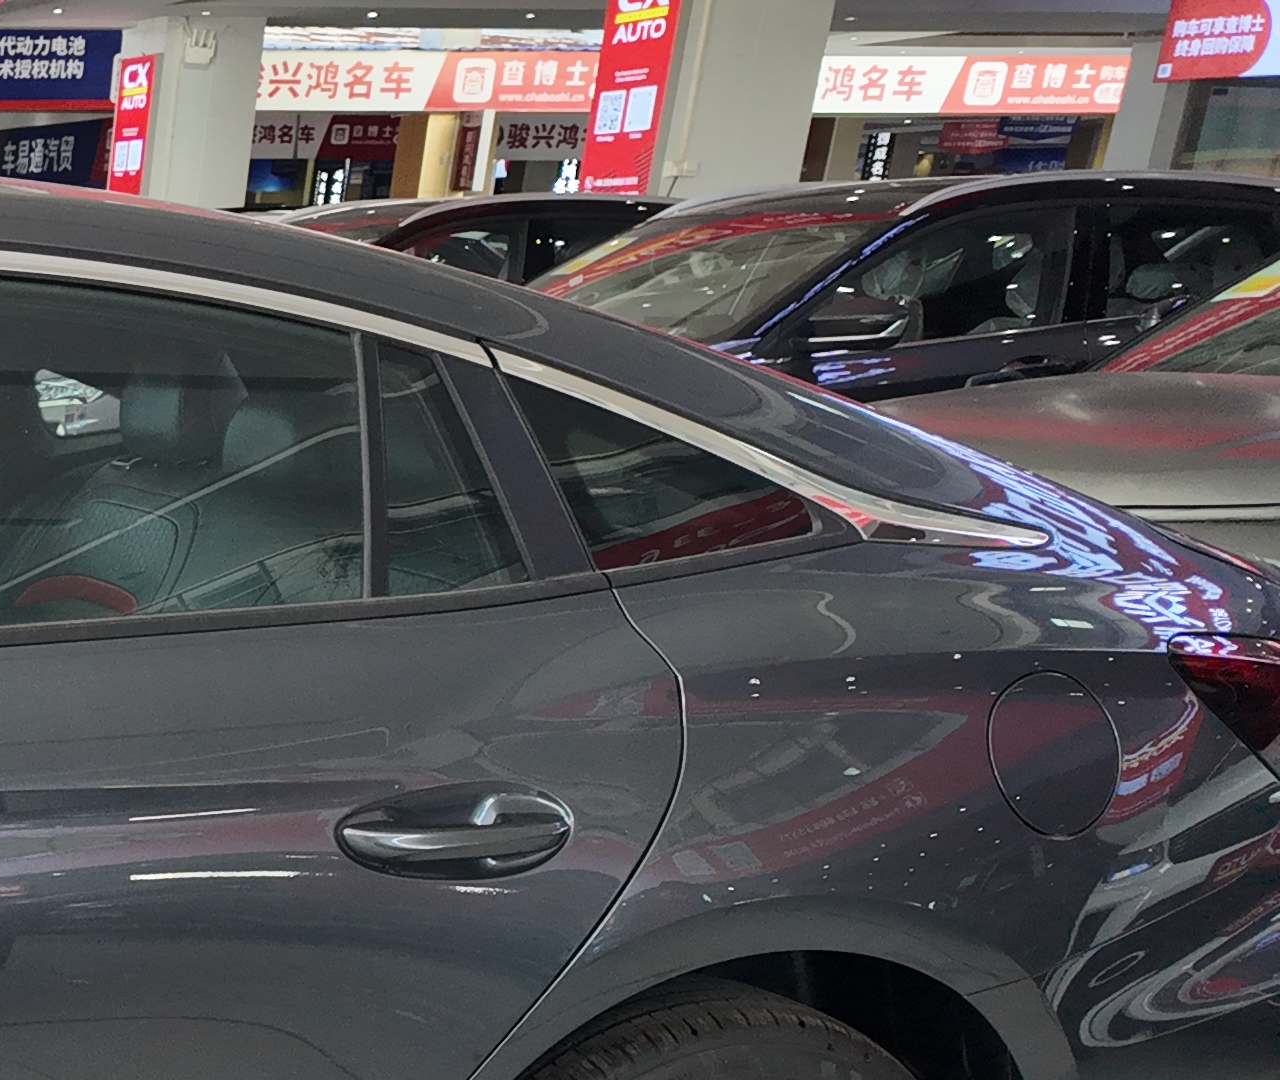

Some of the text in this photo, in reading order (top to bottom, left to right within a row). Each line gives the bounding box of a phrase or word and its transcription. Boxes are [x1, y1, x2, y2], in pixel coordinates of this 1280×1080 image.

[611, 17, 667, 46] AUTO
[123, 62, 151, 89] CX
[499, 59, 591, 87] 查博士
[821, 64, 927, 102] 鸿名车
[1010, 63, 1097, 90] 查博士
[120, 95, 147, 111] AUTO
[506, 122, 587, 150] 骏兴鸿
[1, 134, 76, 176] 车易通汽贸
